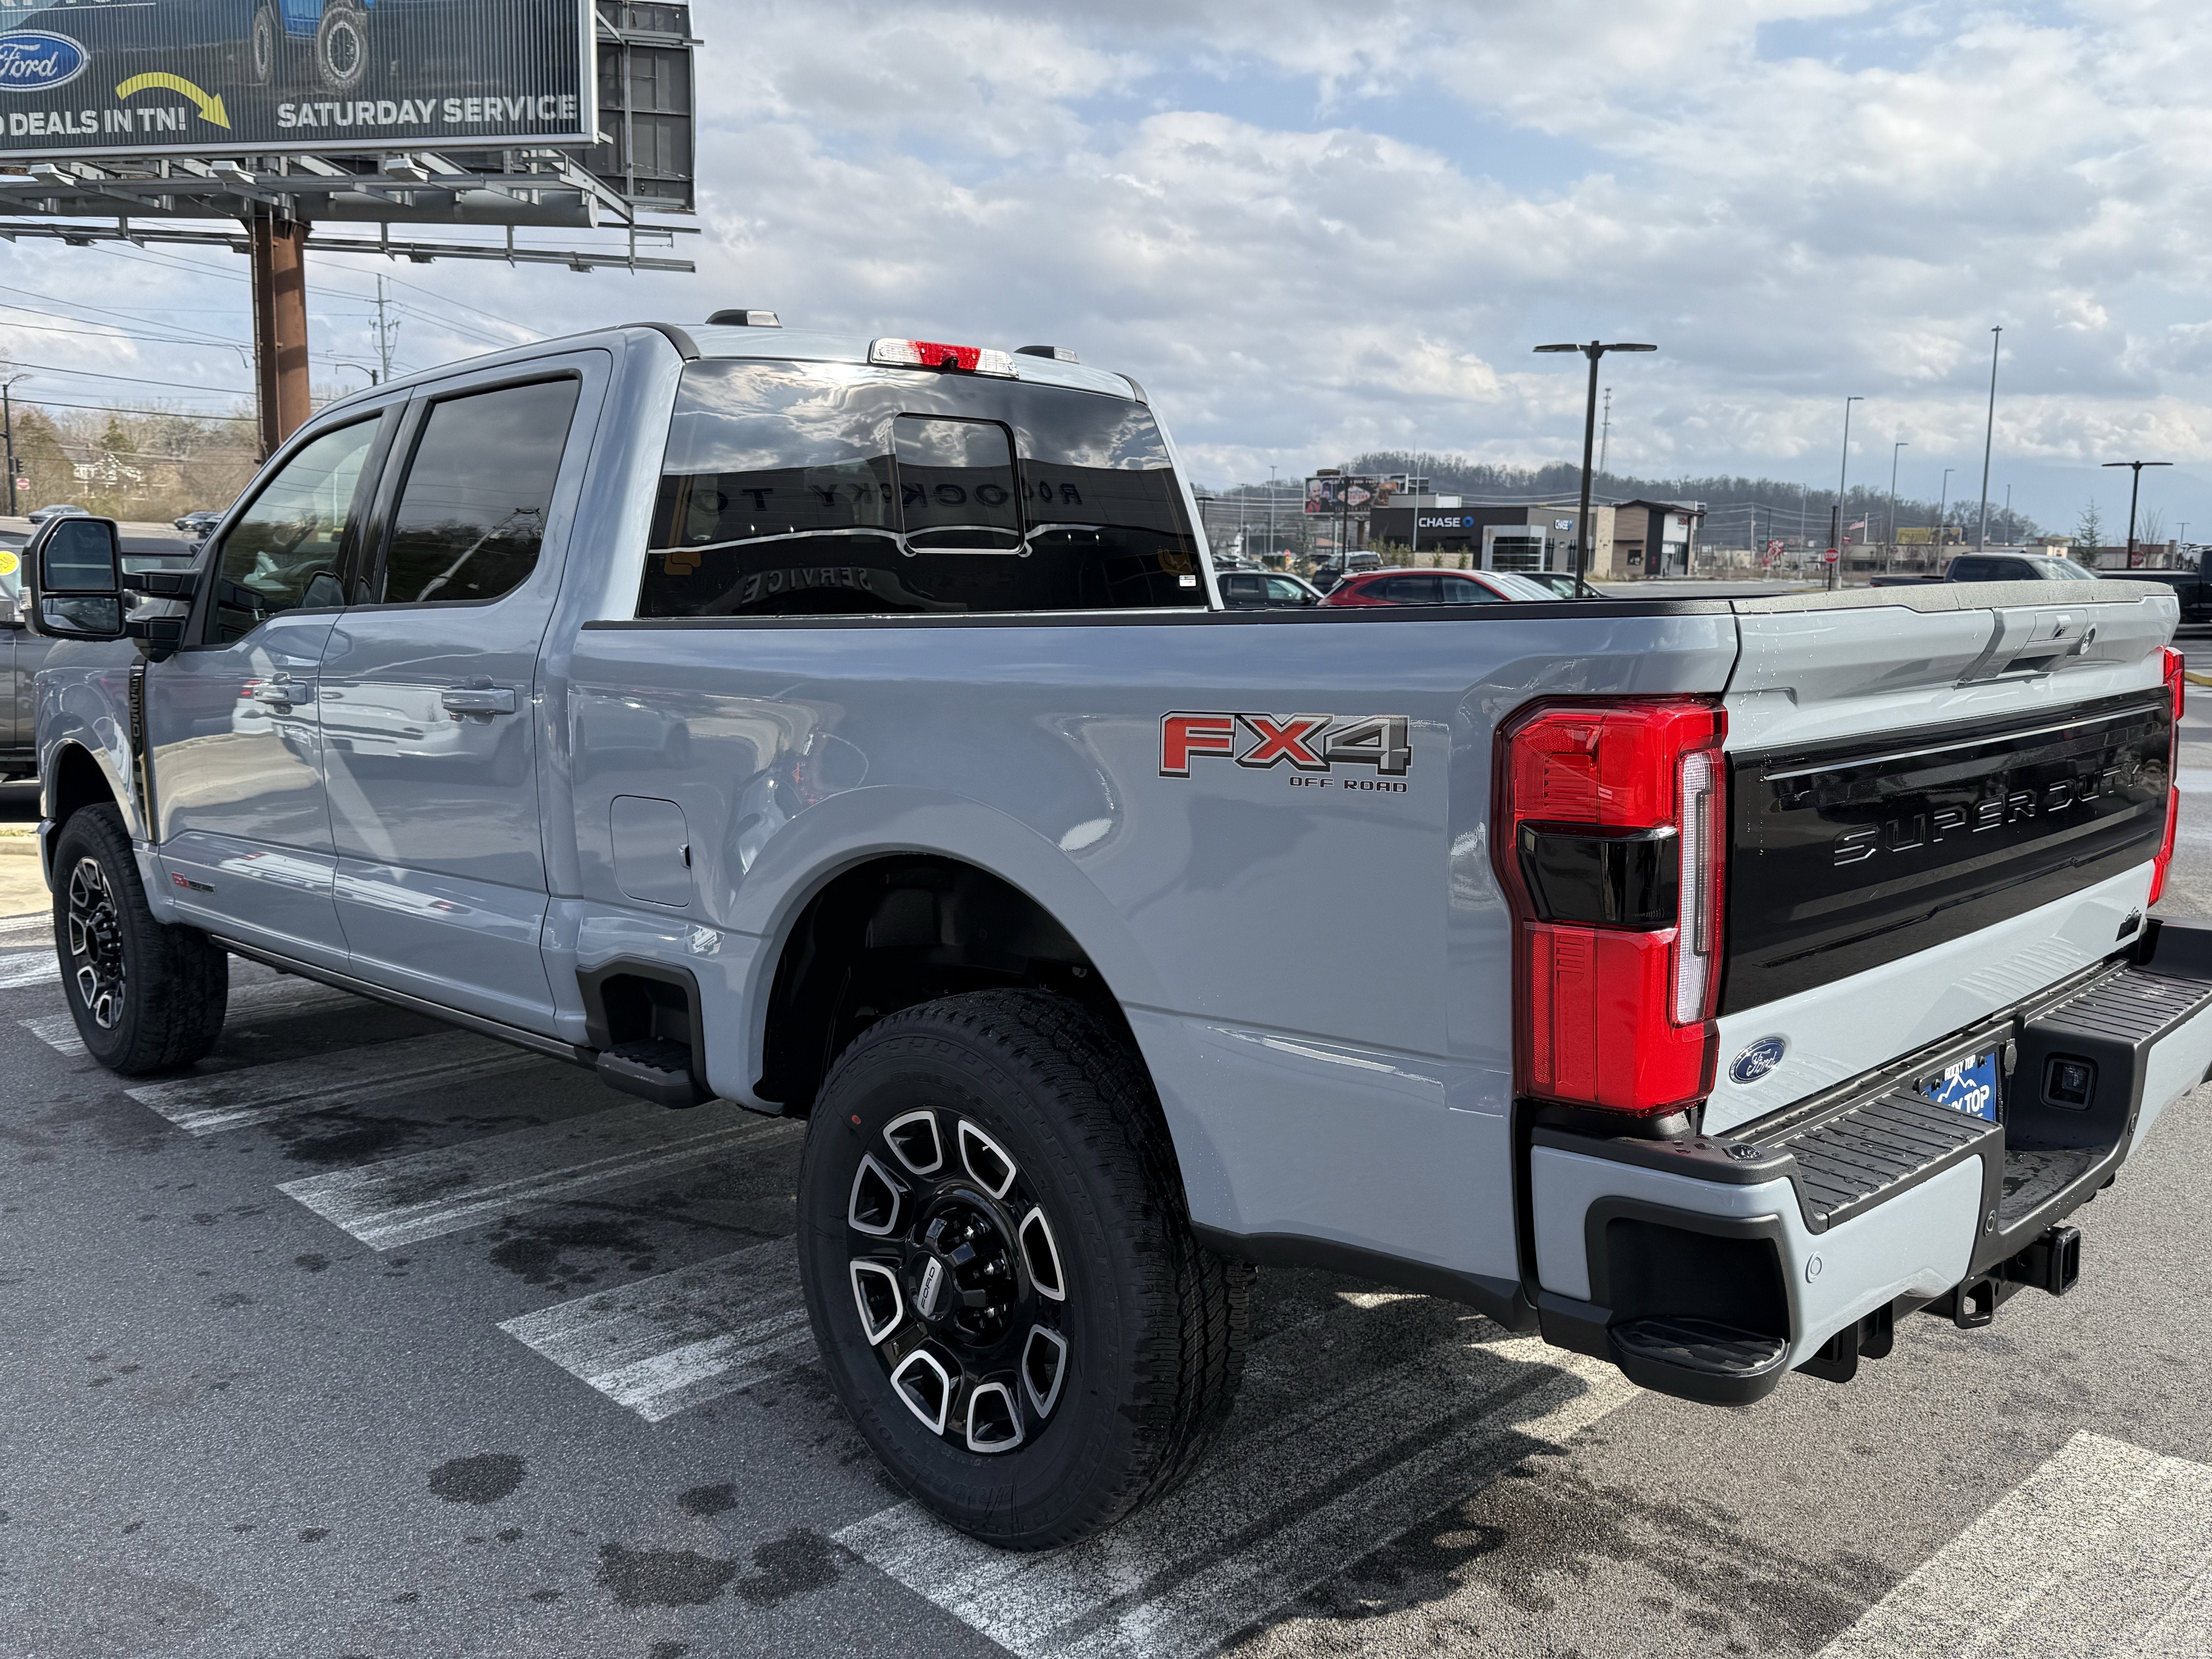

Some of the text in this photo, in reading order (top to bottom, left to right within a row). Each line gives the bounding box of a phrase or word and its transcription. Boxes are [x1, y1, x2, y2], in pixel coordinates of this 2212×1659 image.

[0, 43, 58, 77] Ford
[10, 110, 99, 136] DEALS
[104, 109, 132, 133] IN
[137, 107, 186, 131] TN!
[277, 94, 577, 128] SATURDAY SERVICE
[1419, 517, 1461, 527] CHASE
[1159, 710, 1413, 779] FX4
[1289, 776, 1408, 793] OFF ROAD
[1834, 761, 2140, 866] SUPER DUTY
[1944, 1054, 1976, 1081] ROCKY TOP
[1964, 1084, 1990, 1114] TOP
[921, 1266, 935, 1309] FORD
